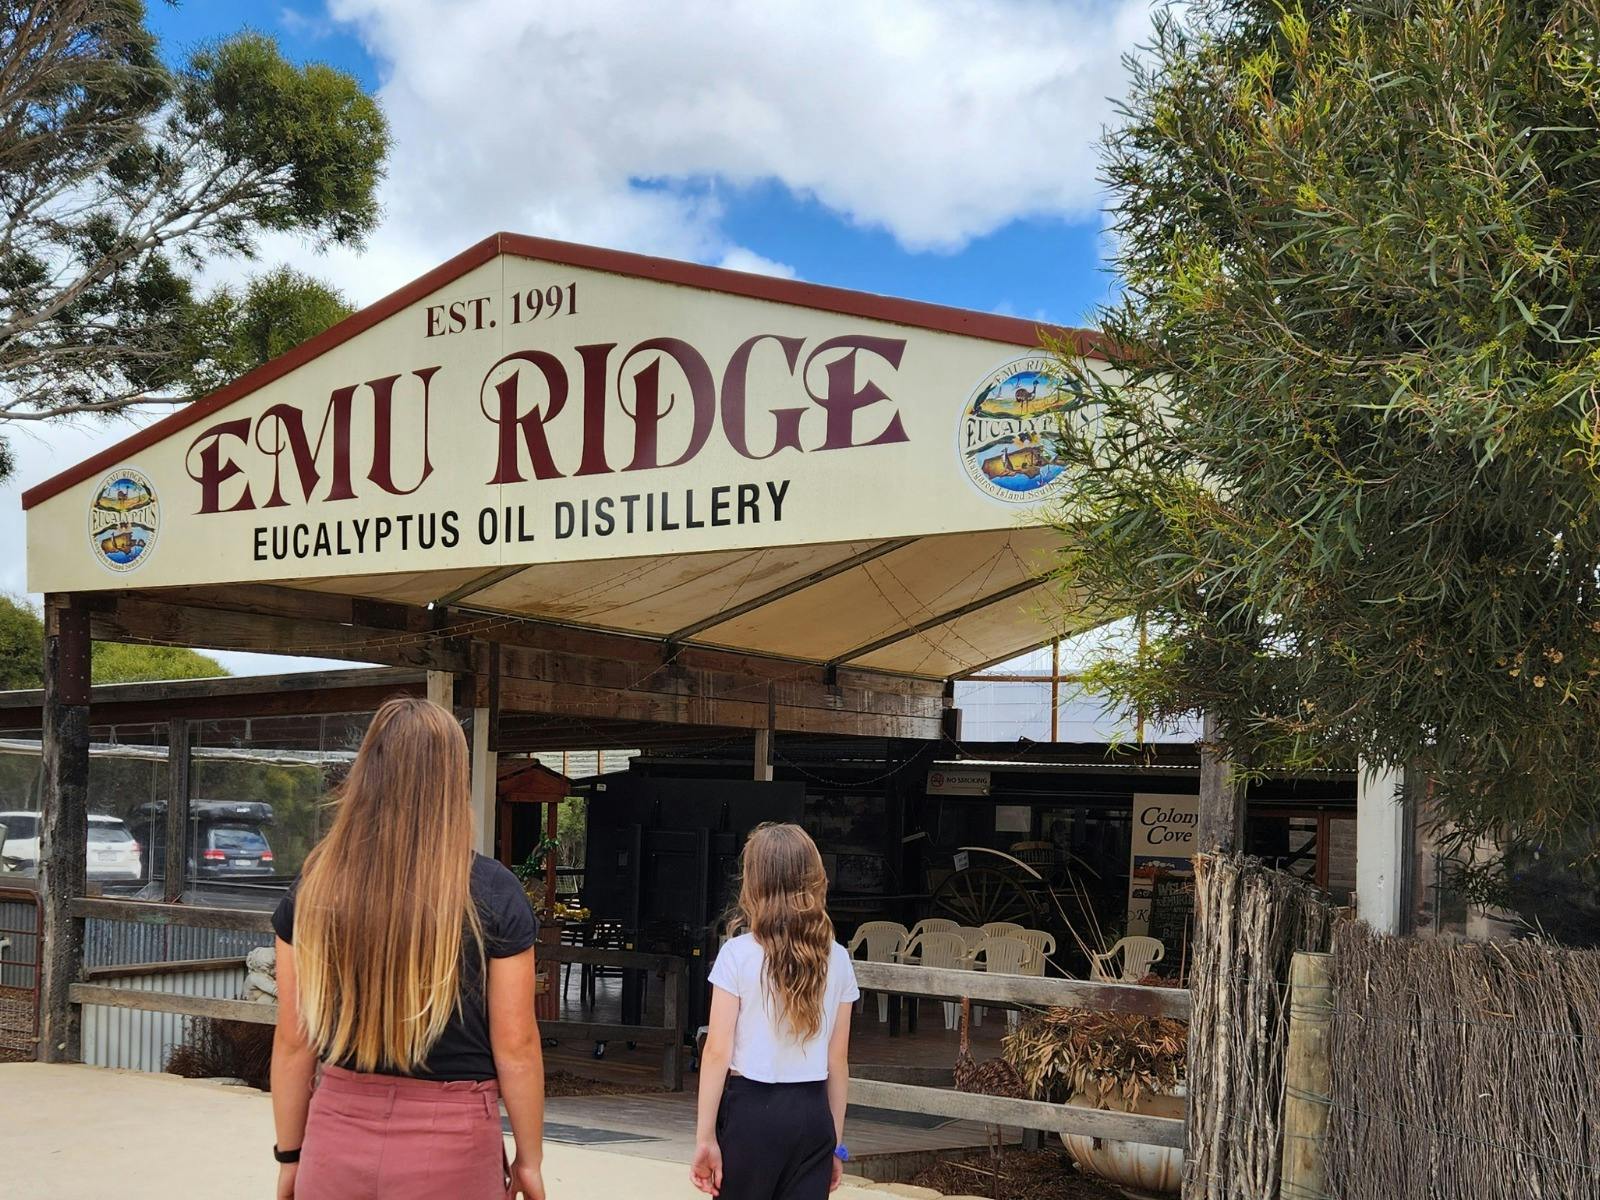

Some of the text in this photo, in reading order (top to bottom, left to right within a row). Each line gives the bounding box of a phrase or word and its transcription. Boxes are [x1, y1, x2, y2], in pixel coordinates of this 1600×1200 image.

[424, 282, 579, 338] EST. 1991
[185, 334, 910, 515] EMU RIDGE
[967, 411, 1090, 448] EUCALYPS
[995, 487, 1025, 501] Island
[92, 503, 157, 531] EUCALYPTUS
[253, 480, 790, 561] EUCALYPTUS OIL DISTILLERY
[946, 776, 957, 784] NO
[1140, 807, 1199, 828] Colony
[1147, 825, 1193, 845] Cove
